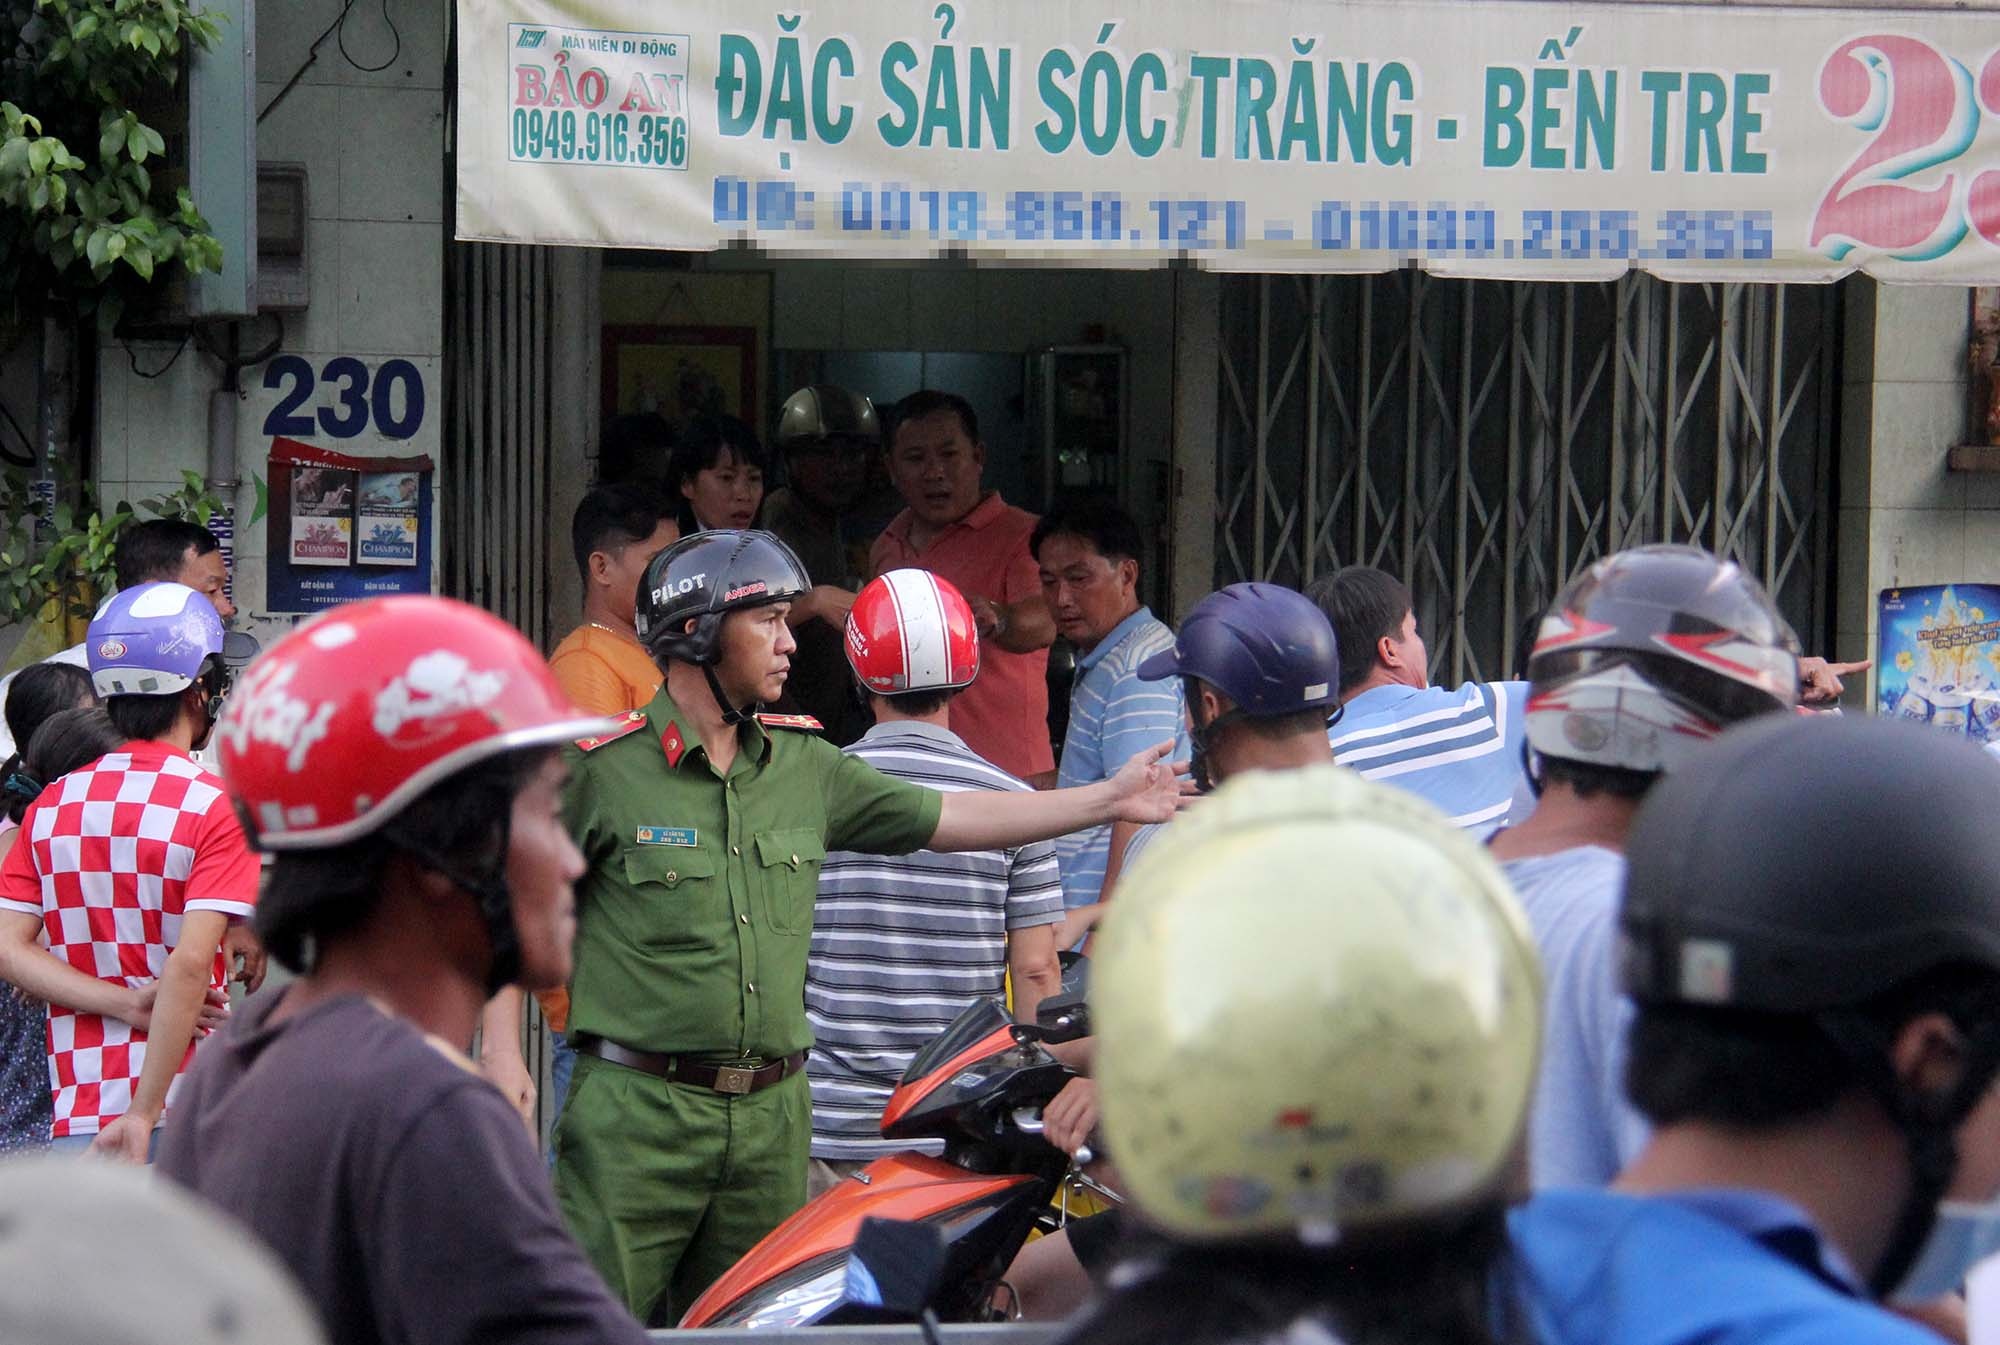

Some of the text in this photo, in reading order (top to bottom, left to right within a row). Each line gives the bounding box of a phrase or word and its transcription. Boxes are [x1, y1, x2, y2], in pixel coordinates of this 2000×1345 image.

[623, 41, 636, 54] DI
[640, 40, 677, 57] ĐỘNG
[515, 50, 683, 112] BẢO AN
[715, 14, 855, 170] ĐẶC
[877, 3, 1011, 150] SẢN
[1034, 23, 1168, 157] SÓC
[1191, 37, 1414, 167] TRĂNG
[1483, 26, 1618, 170] BẾN
[1641, 70, 1771, 174] TRE
[513, 108, 686, 166] 0949.916.356
[262, 355, 425, 440] 230
[652, 573, 706, 605] PILOT
[724, 582, 767, 602] ANDES
